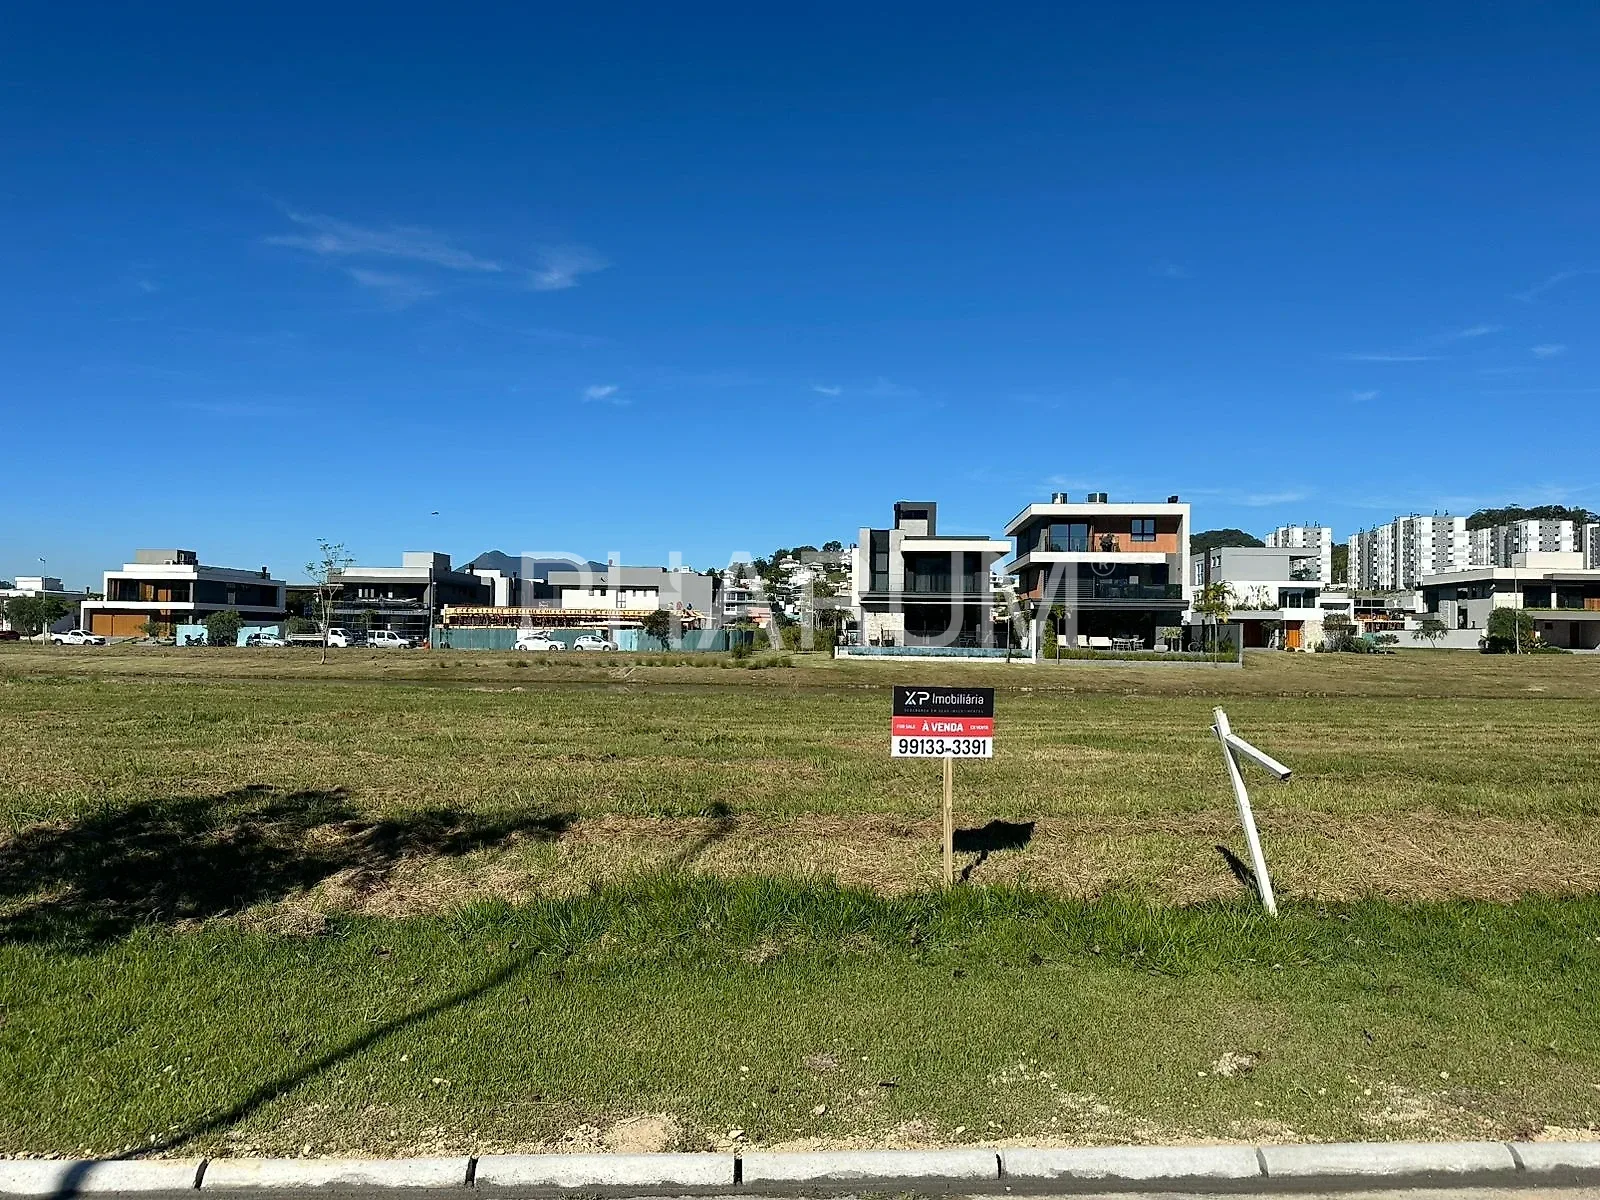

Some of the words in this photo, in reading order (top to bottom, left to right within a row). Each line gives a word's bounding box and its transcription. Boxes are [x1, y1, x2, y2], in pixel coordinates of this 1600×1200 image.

[904, 691, 930, 705] XP
[932, 692, 984, 705] Imobiliária
[922, 720, 930, 732] À
[930, 722, 963, 732] VENDA
[899, 739, 986, 754] 99133-3391
